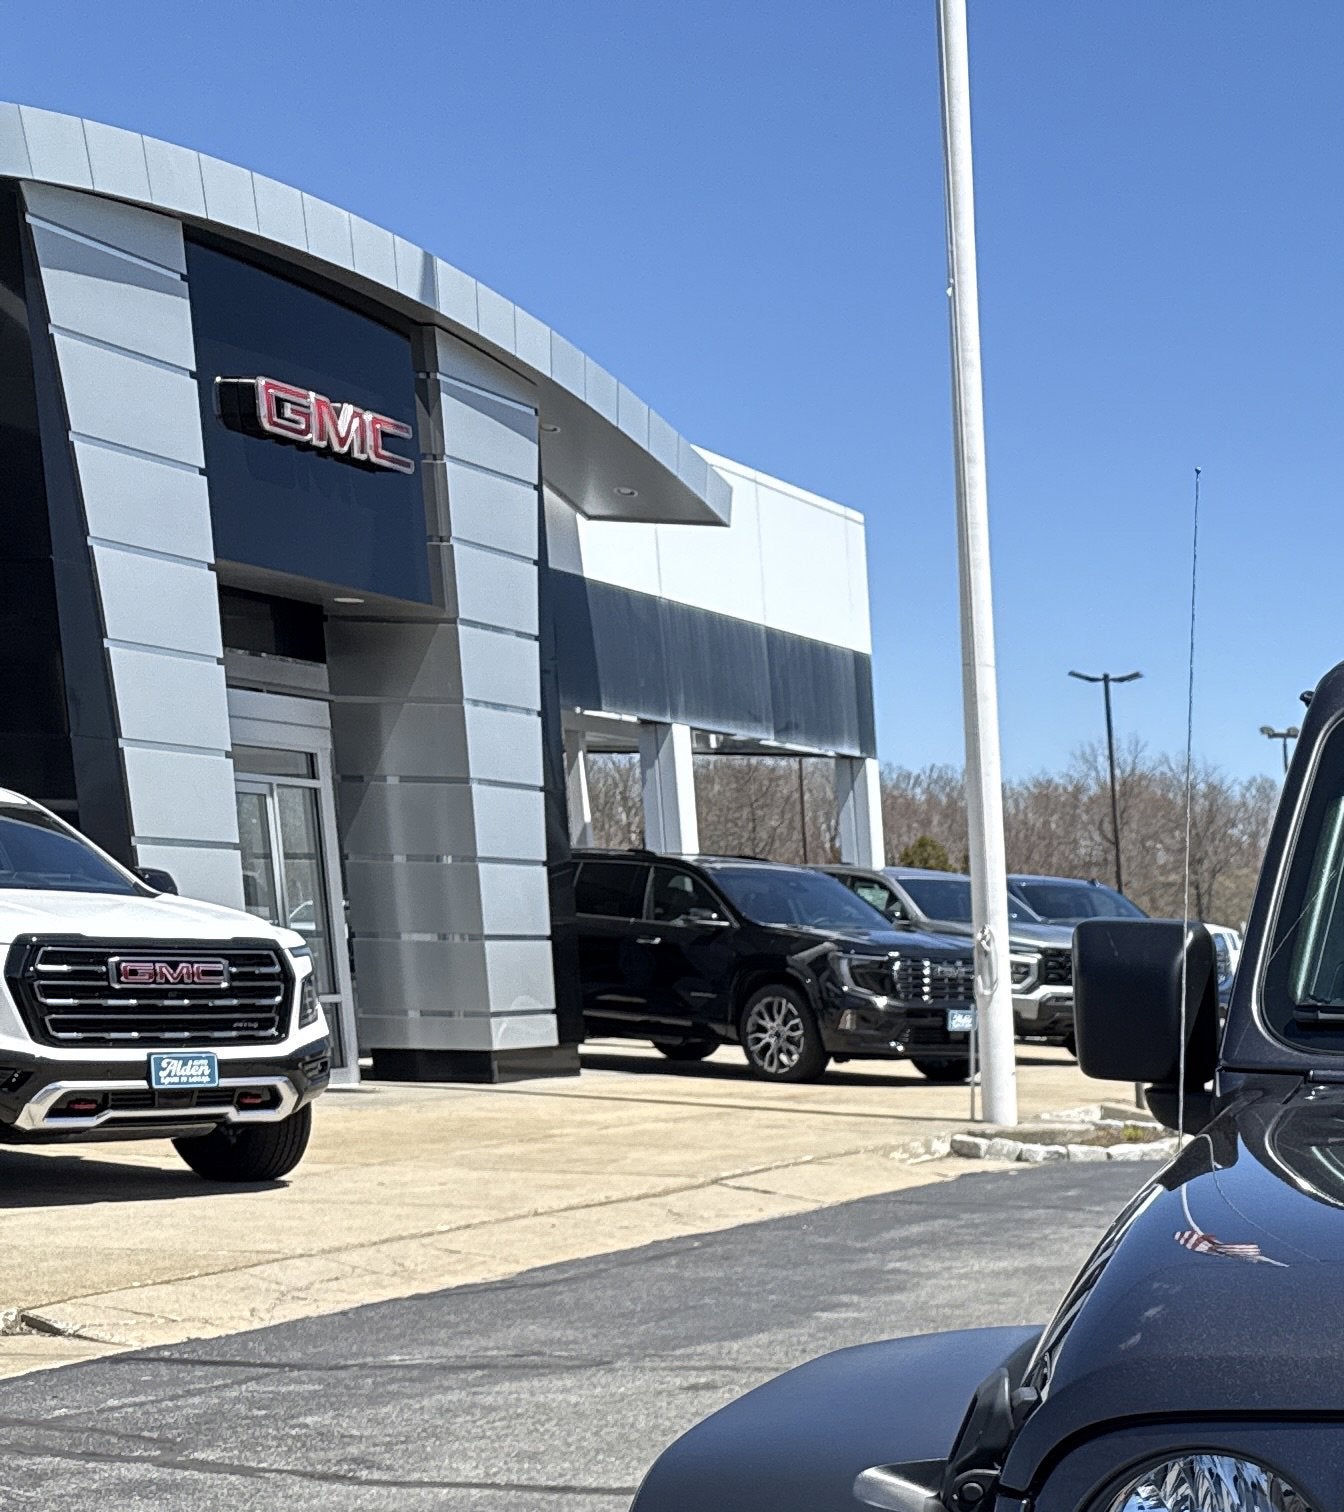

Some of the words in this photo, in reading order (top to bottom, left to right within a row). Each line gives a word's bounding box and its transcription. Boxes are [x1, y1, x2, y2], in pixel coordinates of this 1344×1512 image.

[256, 376, 414, 475] GMC
[120, 963, 224, 983] GMC
[159, 1059, 211, 1076] Alden
